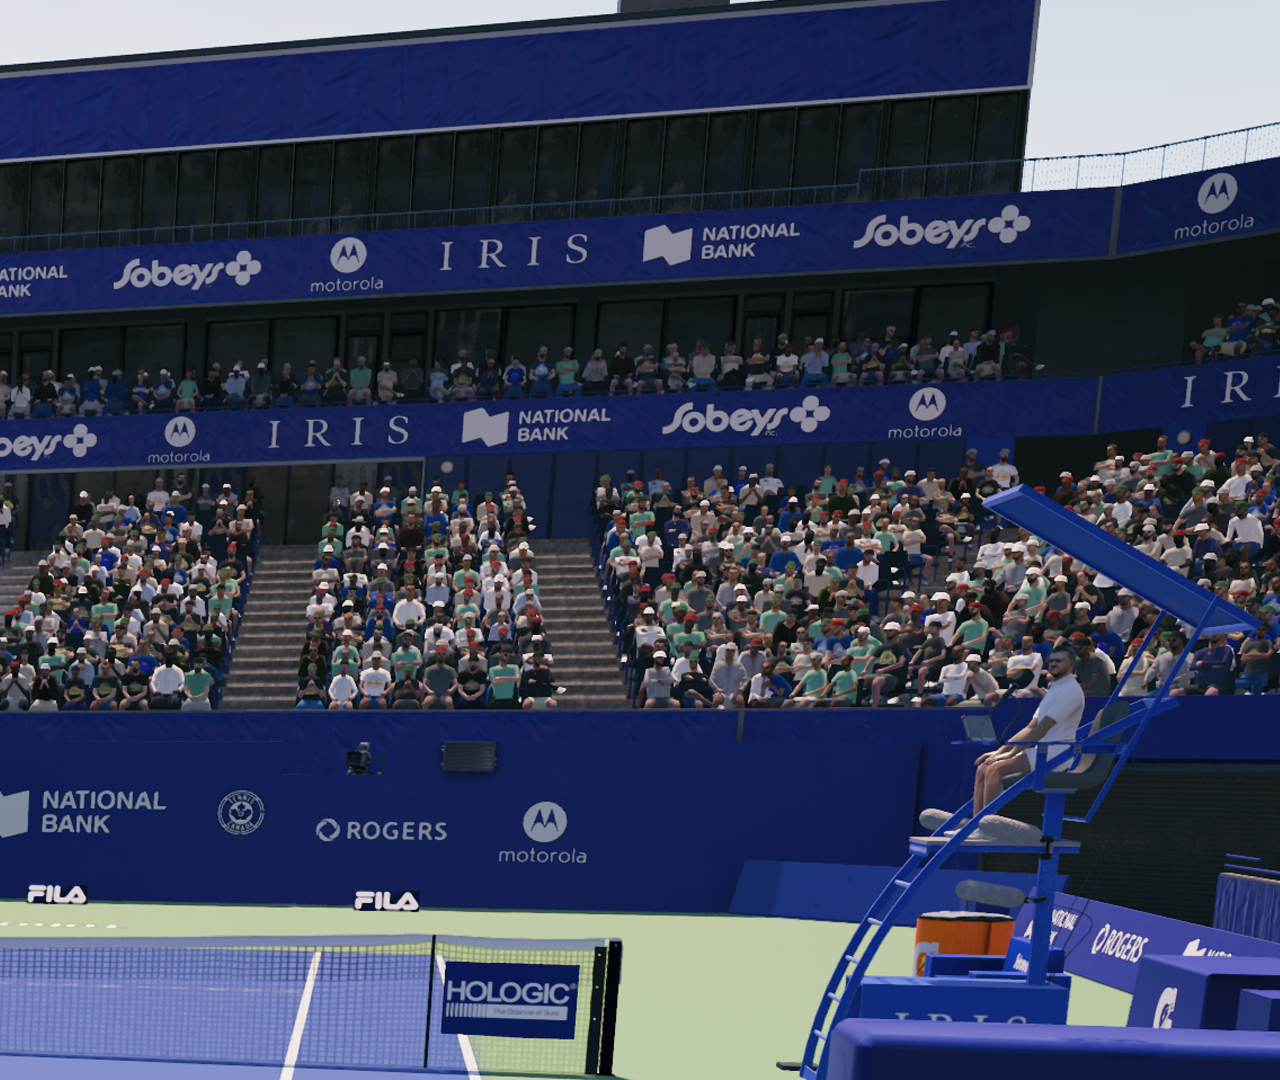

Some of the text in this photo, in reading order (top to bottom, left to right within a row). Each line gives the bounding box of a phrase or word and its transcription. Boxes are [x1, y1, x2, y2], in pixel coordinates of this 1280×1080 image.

[703, 223, 800, 241] NATIONAL
[853, 215, 986, 249] Sobeys
[1175, 214, 1254, 239] motorola
[440, 234, 587, 270] IRIS
[702, 243, 755, 259] BANK
[114, 259, 224, 290] Sobeys
[311, 277, 383, 292] motorola
[519, 408, 611, 424] NATIONAL
[662, 402, 788, 436] Sobeys
[268, 416, 408, 448] IRIS
[518, 427, 568, 441] BANK
[888, 424, 962, 438] motorola
[148, 451, 210, 463] motorola
[43, 790, 166, 810] NATIONAL
[42, 814, 110, 833] BANK
[347, 821, 447, 840] ROGERS
[499, 848, 587, 863] motorola
[26, 883, 88, 905] FILA
[353, 890, 420, 912] FILA
[1102, 929, 1148, 963] ROGERS
